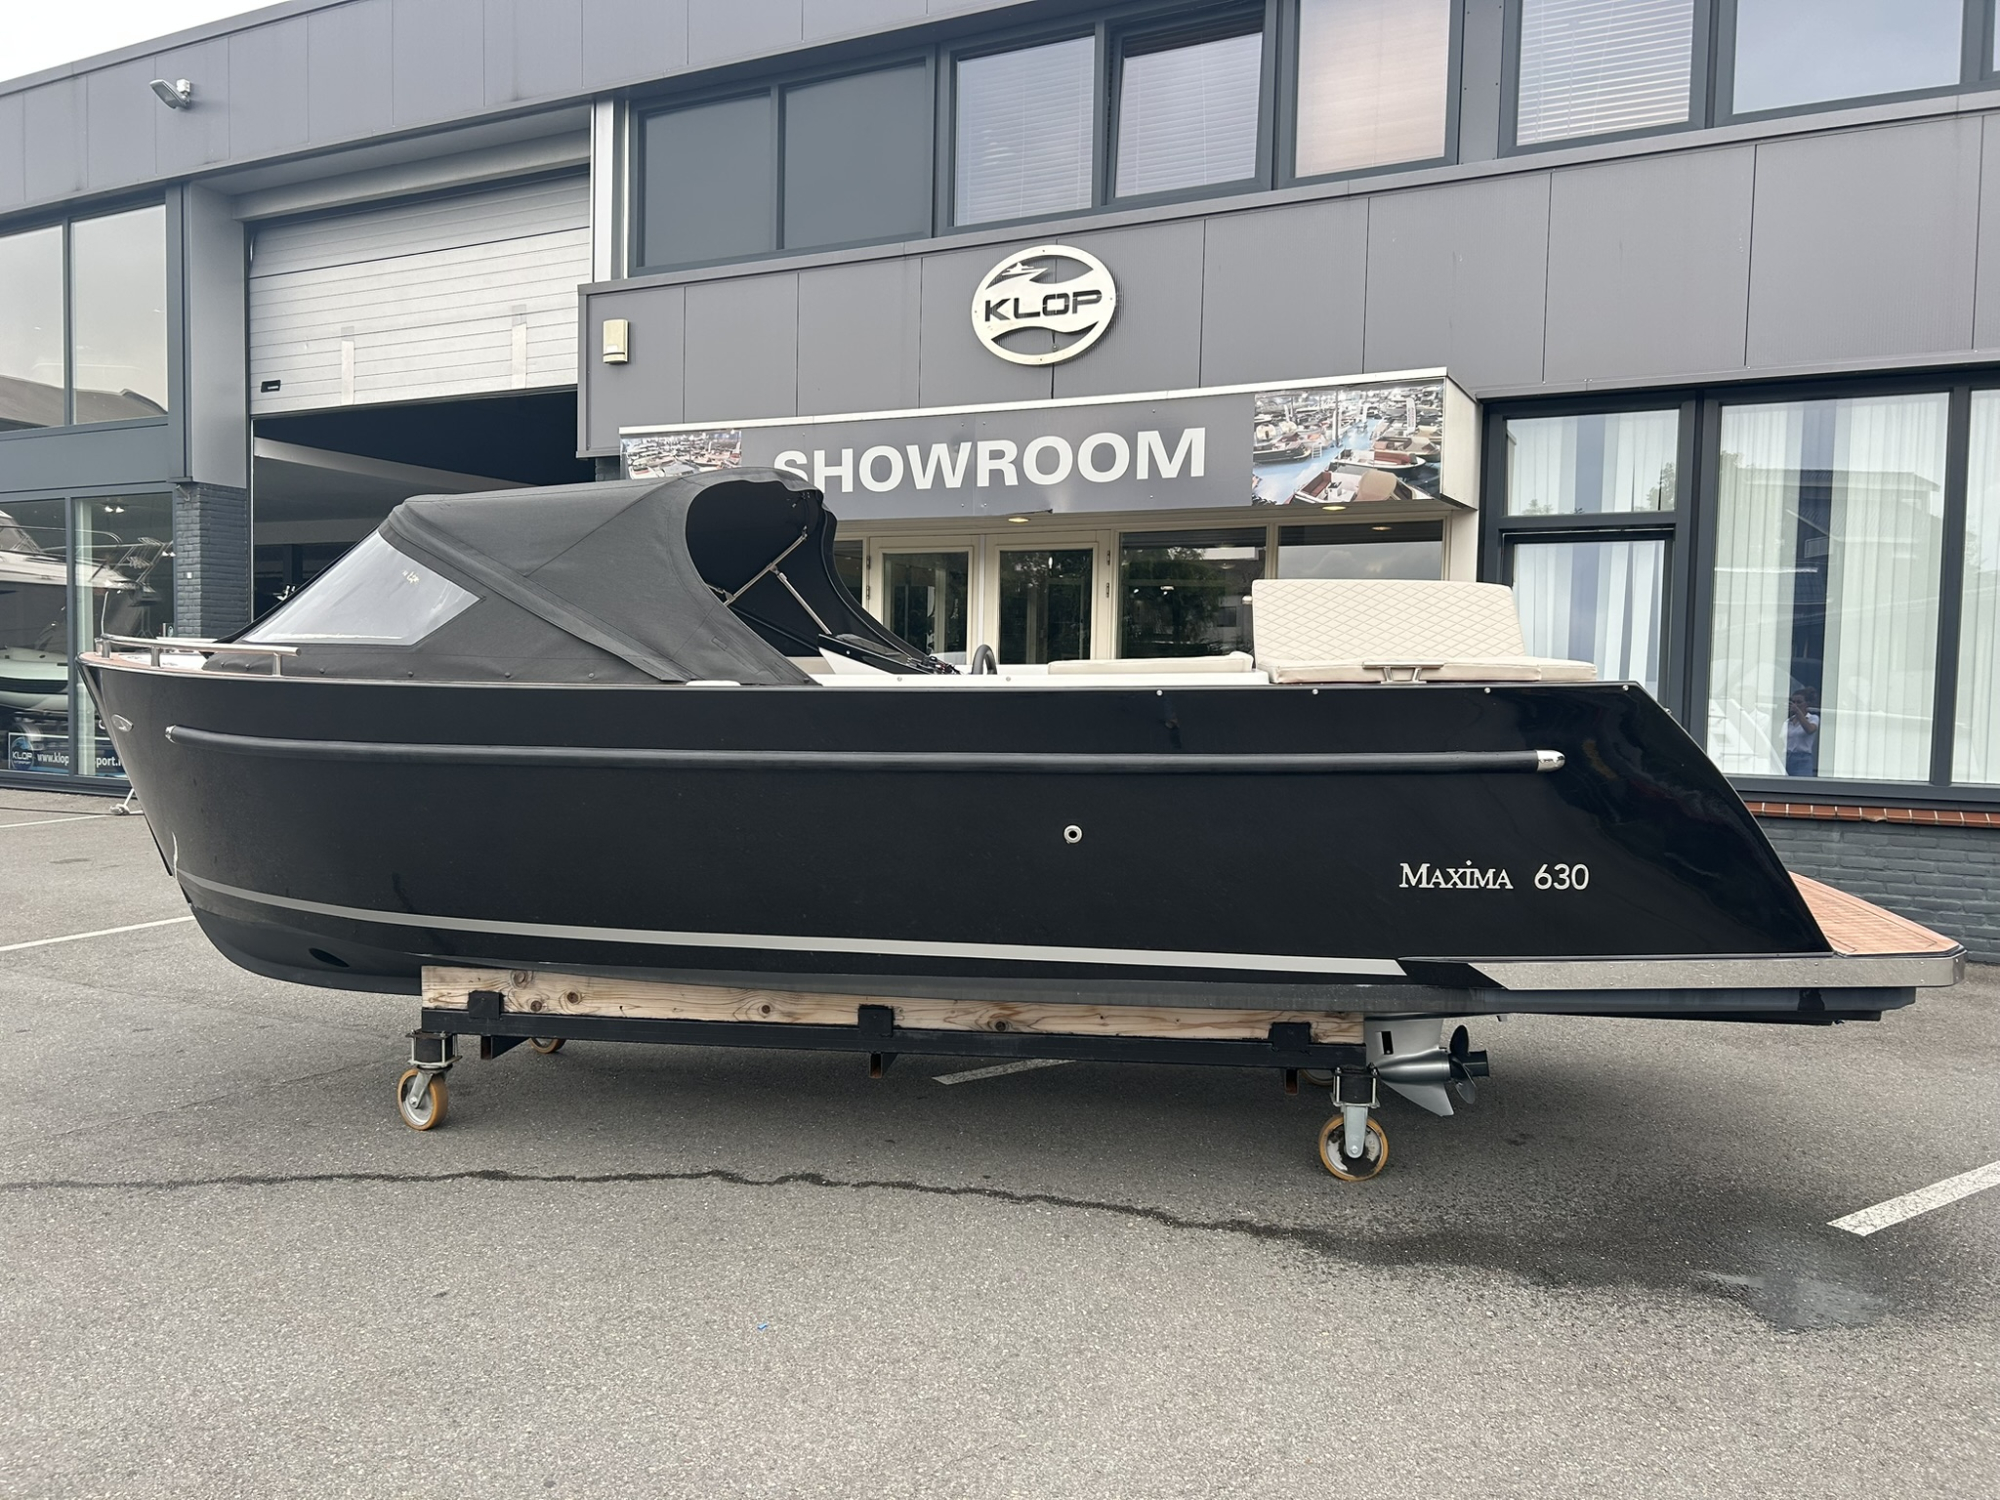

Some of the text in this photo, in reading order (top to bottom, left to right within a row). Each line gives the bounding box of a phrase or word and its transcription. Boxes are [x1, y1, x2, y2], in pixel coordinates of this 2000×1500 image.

[985, 289, 1103, 322] KLOP
[773, 427, 1206, 494] SHOWROOM
[12, 751, 33, 760] KLOP
[1534, 863, 1590, 890] 630
